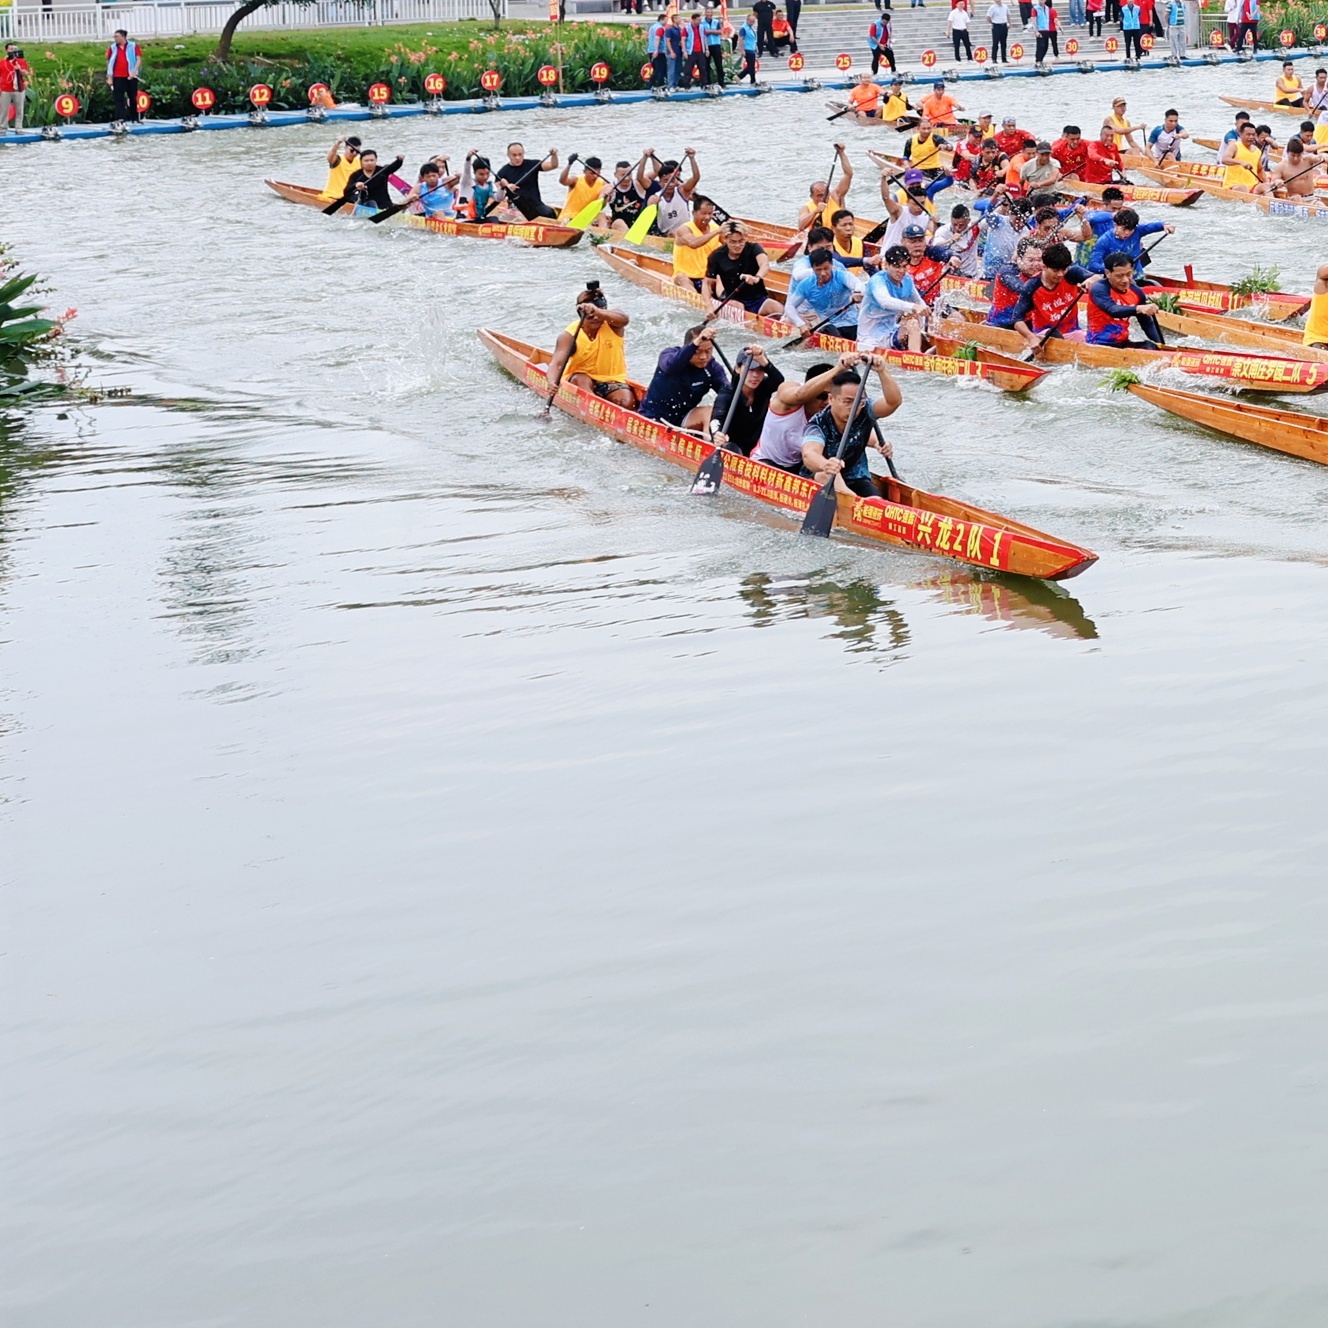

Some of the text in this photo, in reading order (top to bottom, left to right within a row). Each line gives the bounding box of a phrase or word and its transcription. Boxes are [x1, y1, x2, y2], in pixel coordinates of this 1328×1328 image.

[1211, 33, 1222, 44] 35
[1283, 33, 1293, 43] 37
[1316, 27, 1327, 37] 38
[1066, 41, 1078, 52] 30
[1106, 40, 1117, 51] 31
[1142, 37, 1153, 48] 32
[923, 52, 935, 65] 27
[974, 50, 987, 61] 28
[1010, 46, 1023, 58] 29
[790, 56, 803, 69] 23
[837, 56, 850, 68] 25
[541, 68, 556, 82] 18
[593, 66, 608, 80] 19
[428, 77, 444, 92] 16
[485, 73, 499, 87] 17
[195, 92, 212, 106] 11
[253, 88, 269, 102] 12
[372, 87, 388, 100] 15
[61, 97, 74, 114] 9
[1305, 363, 1318, 385] 5
[989, 530, 1003, 567] 1
